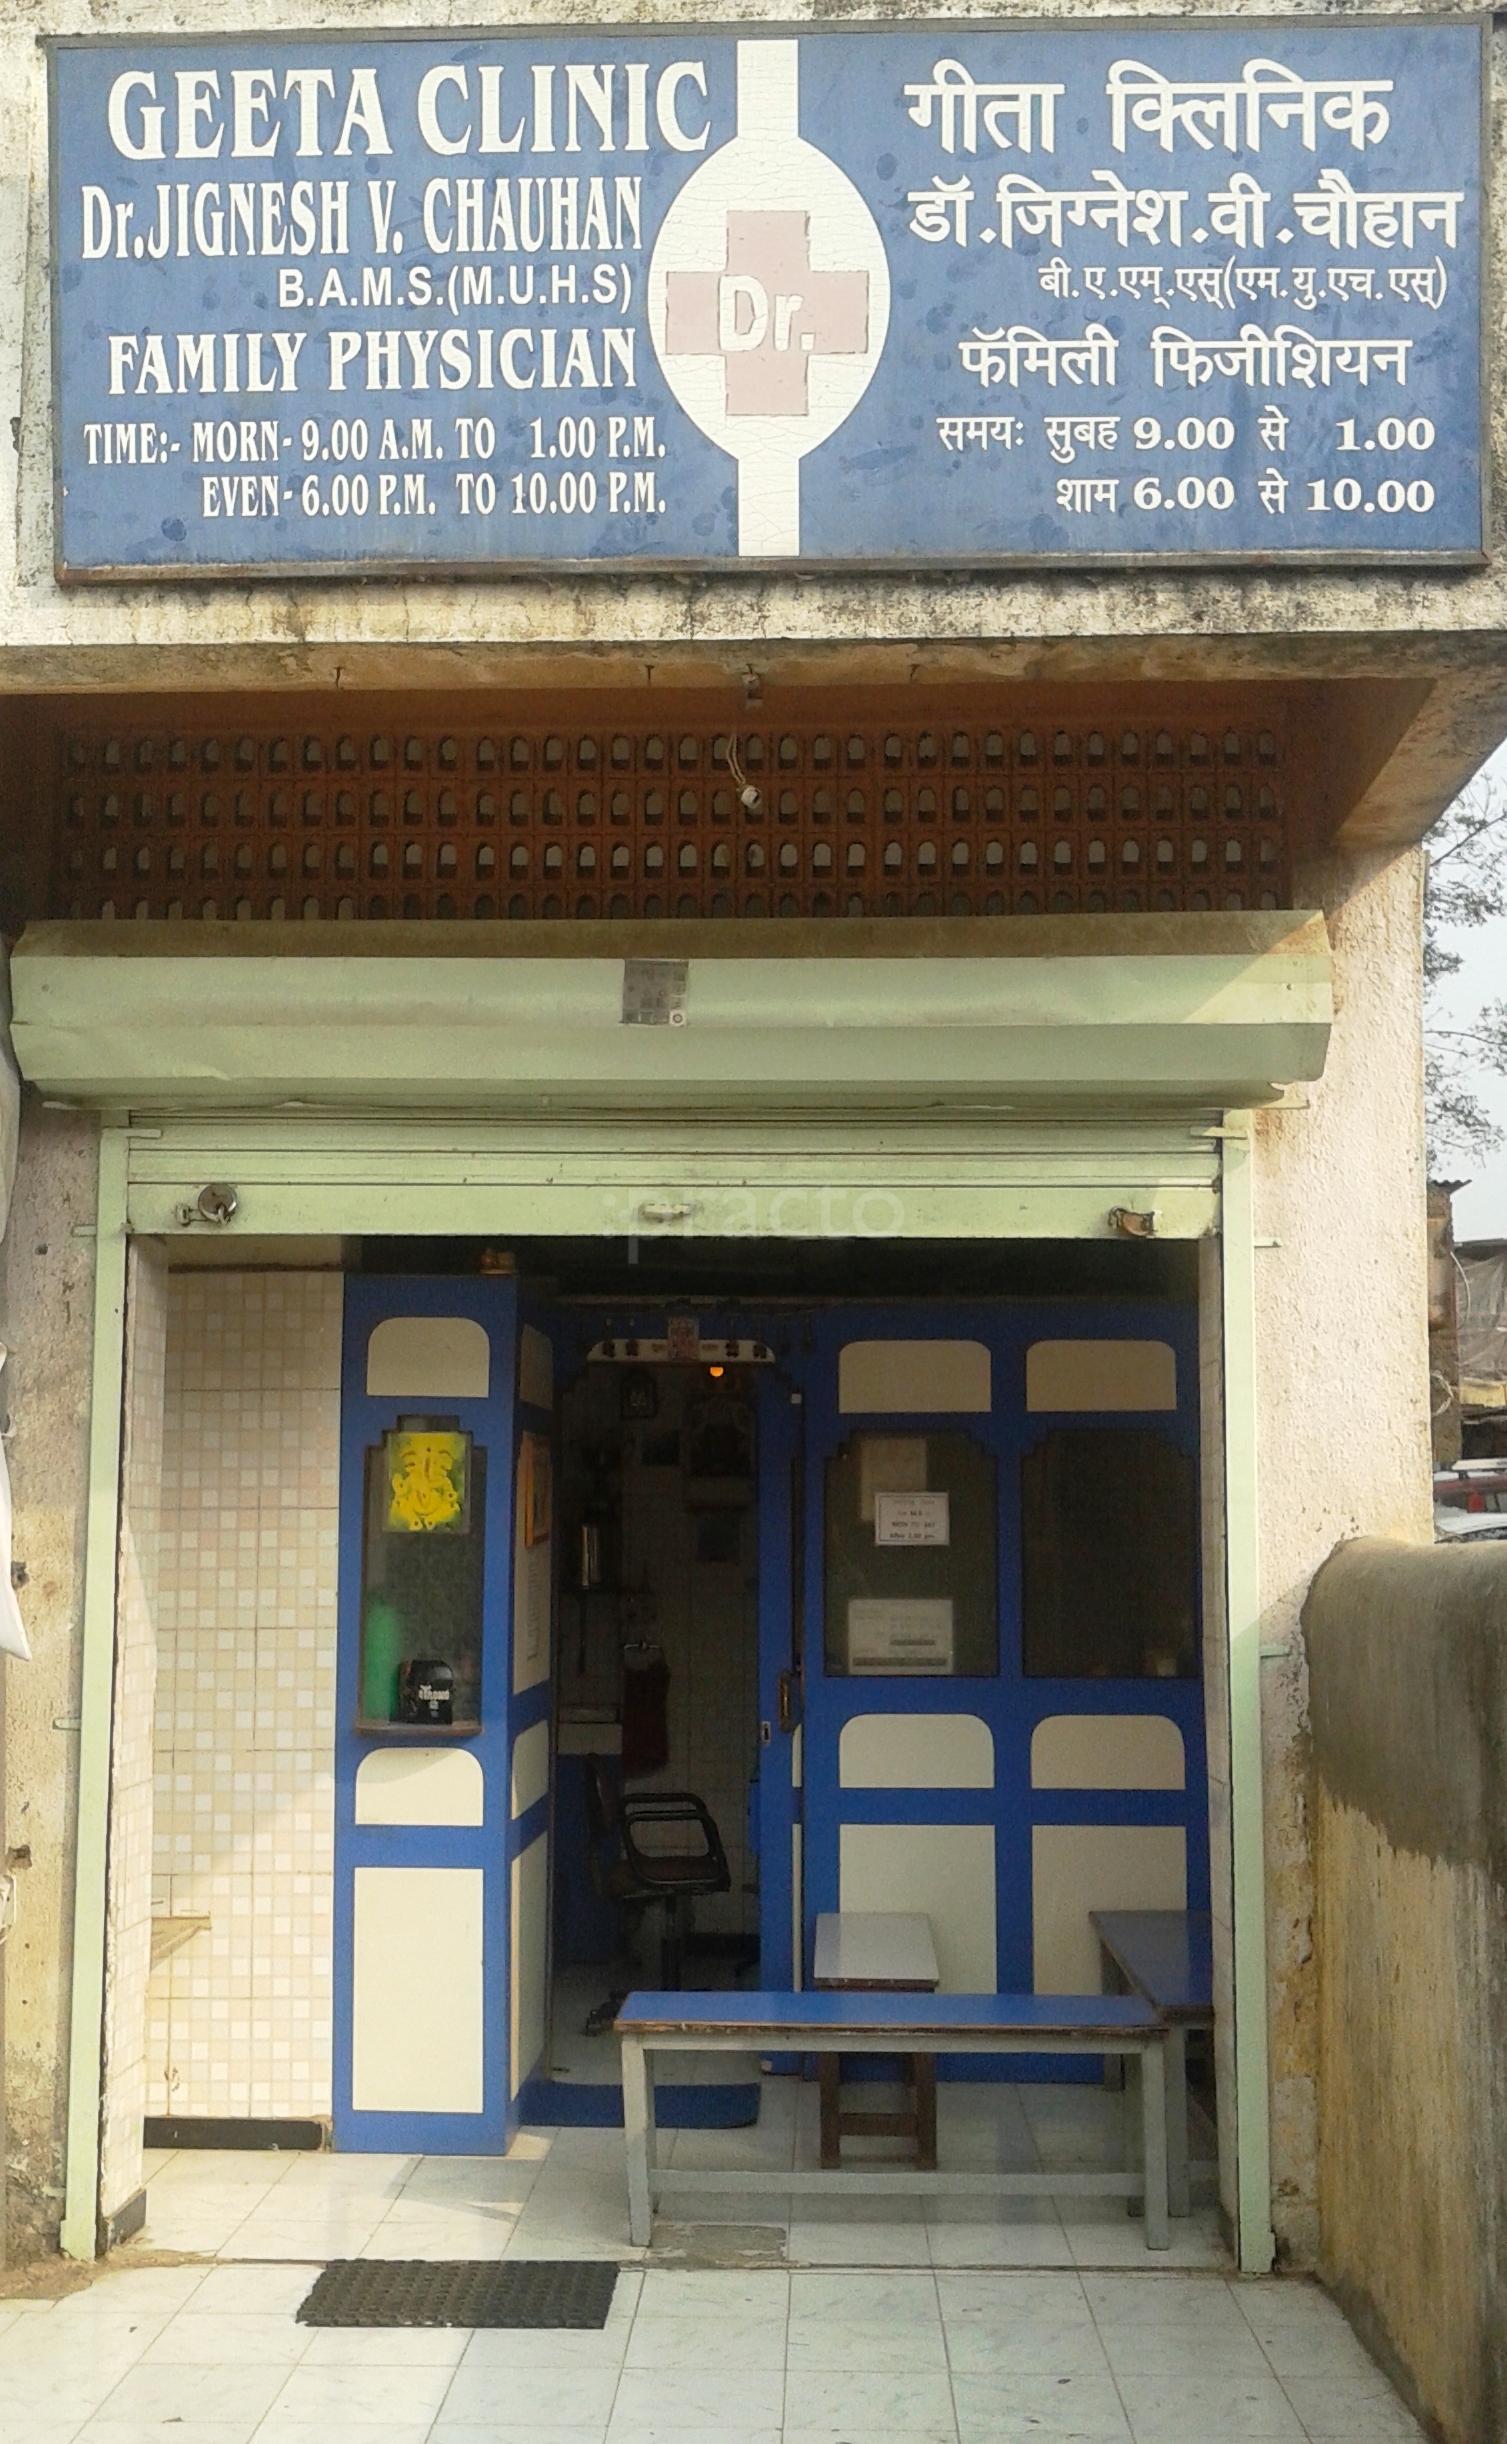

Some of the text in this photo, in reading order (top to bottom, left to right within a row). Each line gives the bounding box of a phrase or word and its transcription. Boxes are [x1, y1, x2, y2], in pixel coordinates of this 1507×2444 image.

[108, 60, 712, 160] GEETA CLINIC
[903, 58, 1394, 154] गीता क्लिनिक
[81, 176, 642, 259] Dr.JIGNESH V. CHAUHAN
[718, 275, 815, 352] Dr.
[108, 327, 637, 395] FAMILY PHYSICIAN
[1150, 323, 1413, 389] फिजीशियन
[83, 422, 181, 465] TIME:-
[301, 419, 368, 461] 9.00
[379, 418, 443, 460] A.M.
[455, 417, 495, 459] TO
[530, 416, 596, 458] 1.00
[608, 416, 666, 458] P.M.
[1043, 416, 1121, 464] सुबह
[1133, 417, 1235, 450] 9.00
[1257, 405, 1289, 451] से
[1336, 416, 1435, 450] 1.00
[302, 474, 369, 516] 6.00
[379, 474, 436, 515] P.M.
[455, 473, 496, 515] TO
[511, 472, 597, 514] 10.00
[609, 471, 666, 513] P.M.
[1056, 467, 1435, 514] शाम 6.00 से 10.00
